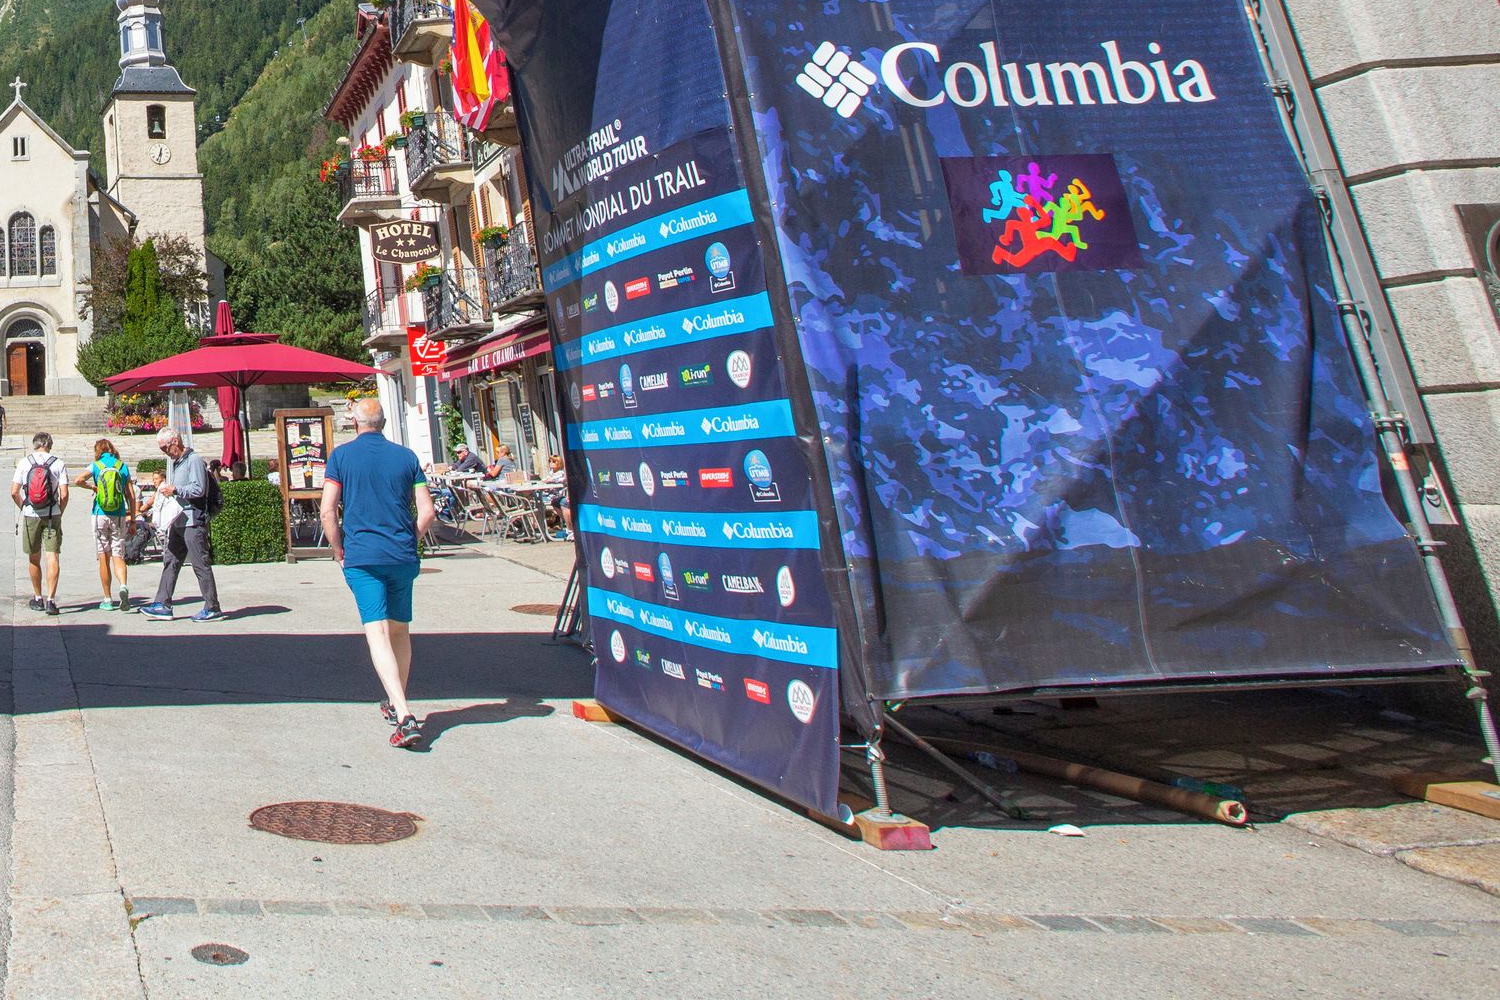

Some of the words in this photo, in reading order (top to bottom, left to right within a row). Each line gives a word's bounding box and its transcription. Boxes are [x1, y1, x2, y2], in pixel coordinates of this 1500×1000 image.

[880, 39, 1217, 108] Columbia
[578, 152, 614, 187] WORLD
[611, 136, 649, 169] TOUR
[543, 217, 575, 255] SOMMET
[576, 191, 628, 236] MONDIAL
[629, 180, 652, 211] DU
[654, 160, 706, 199] TRAIL
[376, 223, 432, 240] HOTEL
[668, 209, 717, 235] Columbia
[376, 245, 388, 255] Le
[391, 244, 438, 259] Chamonix
[613, 232, 646, 254] Columbia
[692, 309, 744, 332] Columbia
[630, 325, 666, 344] Columbia
[467, 358, 478, 373] BAR
[482, 354, 489, 370] LE
[649, 422, 685, 438] Columbia
[712, 414, 760, 432] Columbia
[669, 520, 706, 539] Columbia
[734, 521, 793, 540] Columbia
[722, 575, 764, 593] CAMELBAK
[692, 620, 731, 644] Columbia
